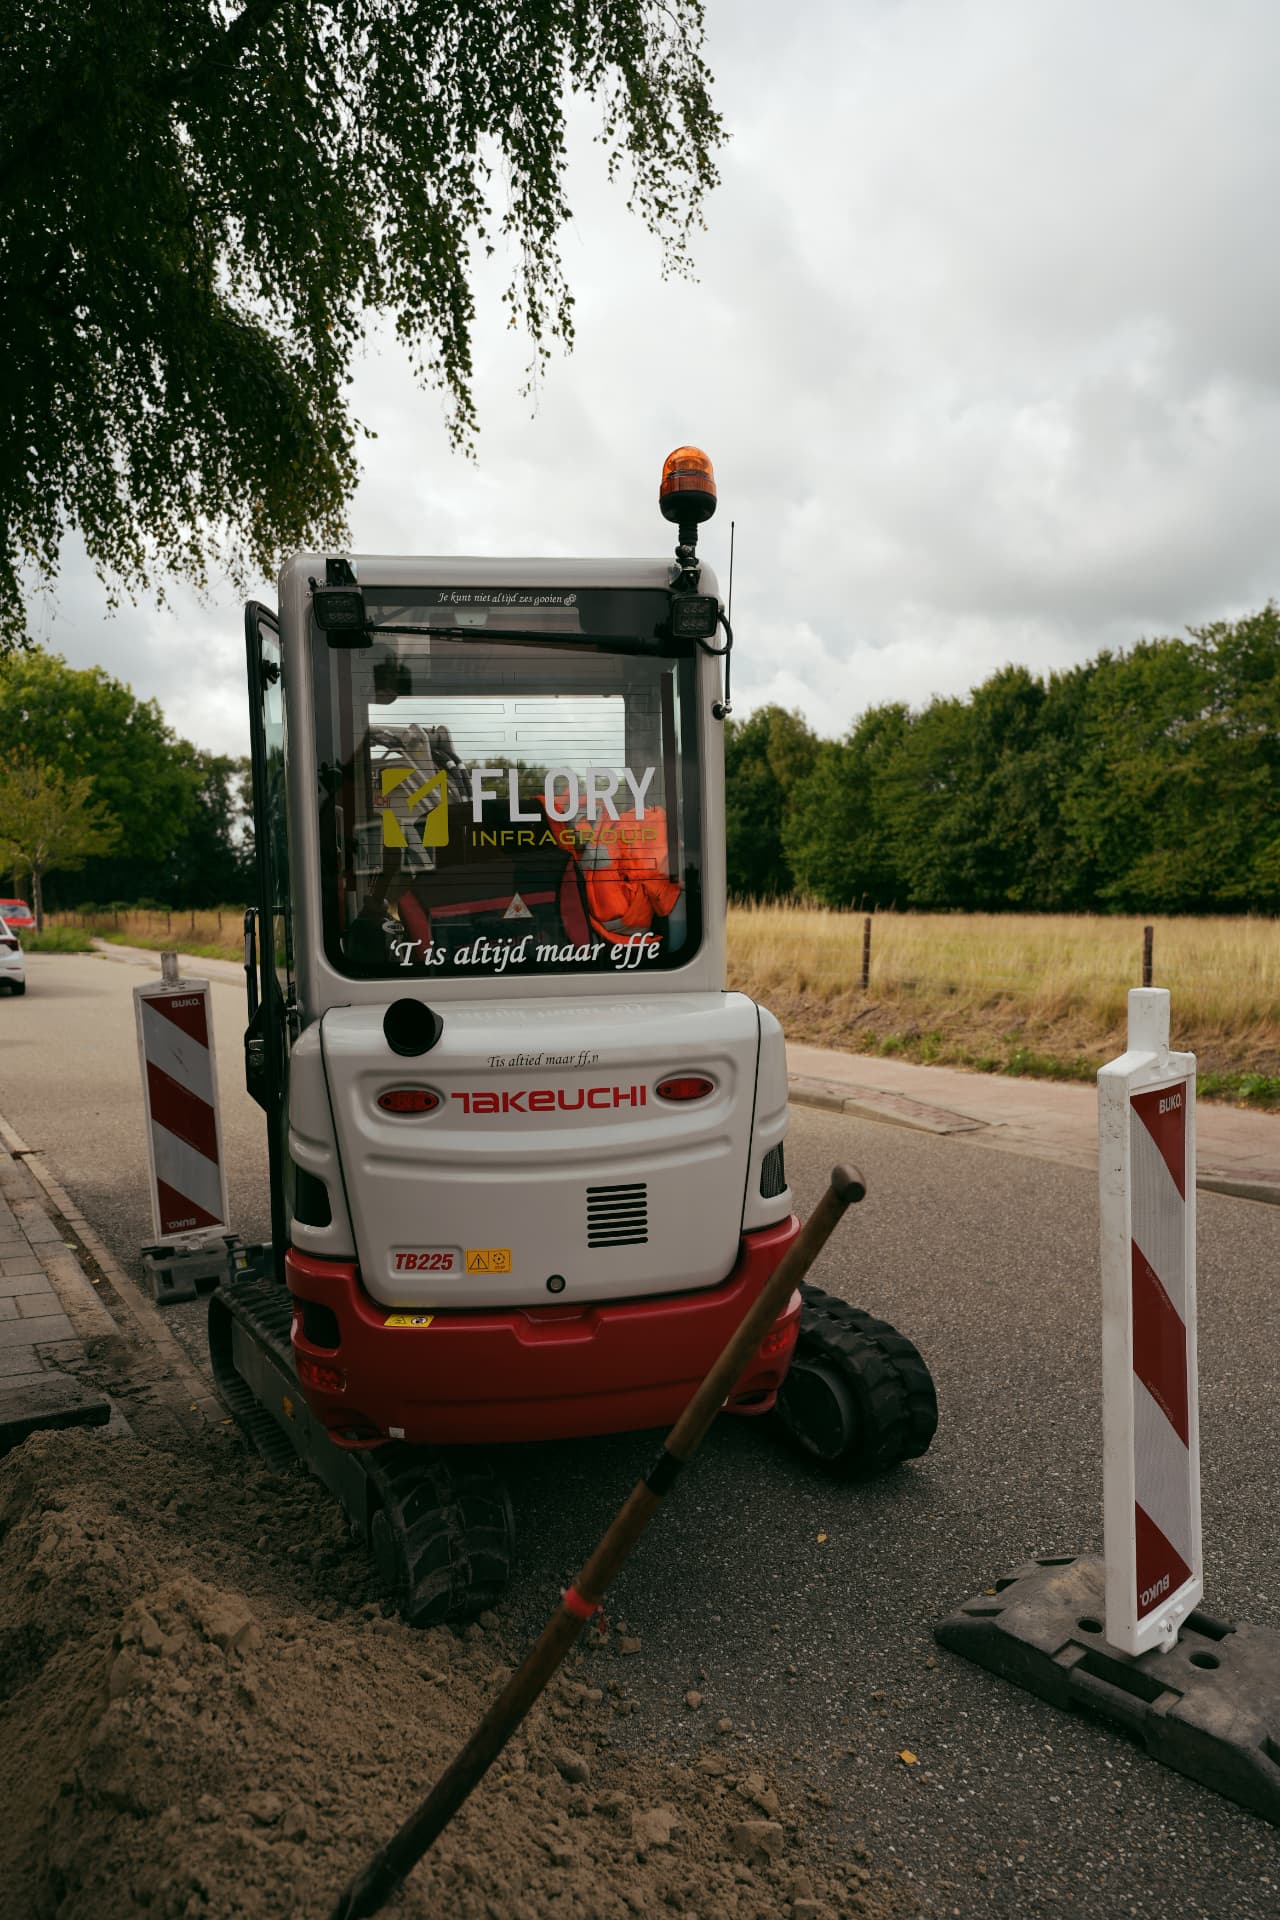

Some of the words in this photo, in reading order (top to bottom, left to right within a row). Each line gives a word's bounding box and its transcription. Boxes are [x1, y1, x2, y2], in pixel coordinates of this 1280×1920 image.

[437, 592, 449, 603] Je
[450, 591, 471, 604] kunt
[474, 592, 491, 602] niet
[491, 592, 519, 606] altijd
[519, 595, 533, 603] zes
[533, 593, 563, 607] gooien
[471, 766, 656, 824] FLORY
[472, 828, 658, 848] INFRAGROUP
[423, 939, 447, 966] is
[453, 935, 534, 973] altijd
[535, 942, 605, 963] maar
[610, 932, 661, 969] effe
[508, 1052, 545, 1067] altied
[545, 1055, 576, 1066] maar
[451, 1084, 647, 1115] TAKEUCHI
[395, 1253, 454, 1271] TB225
